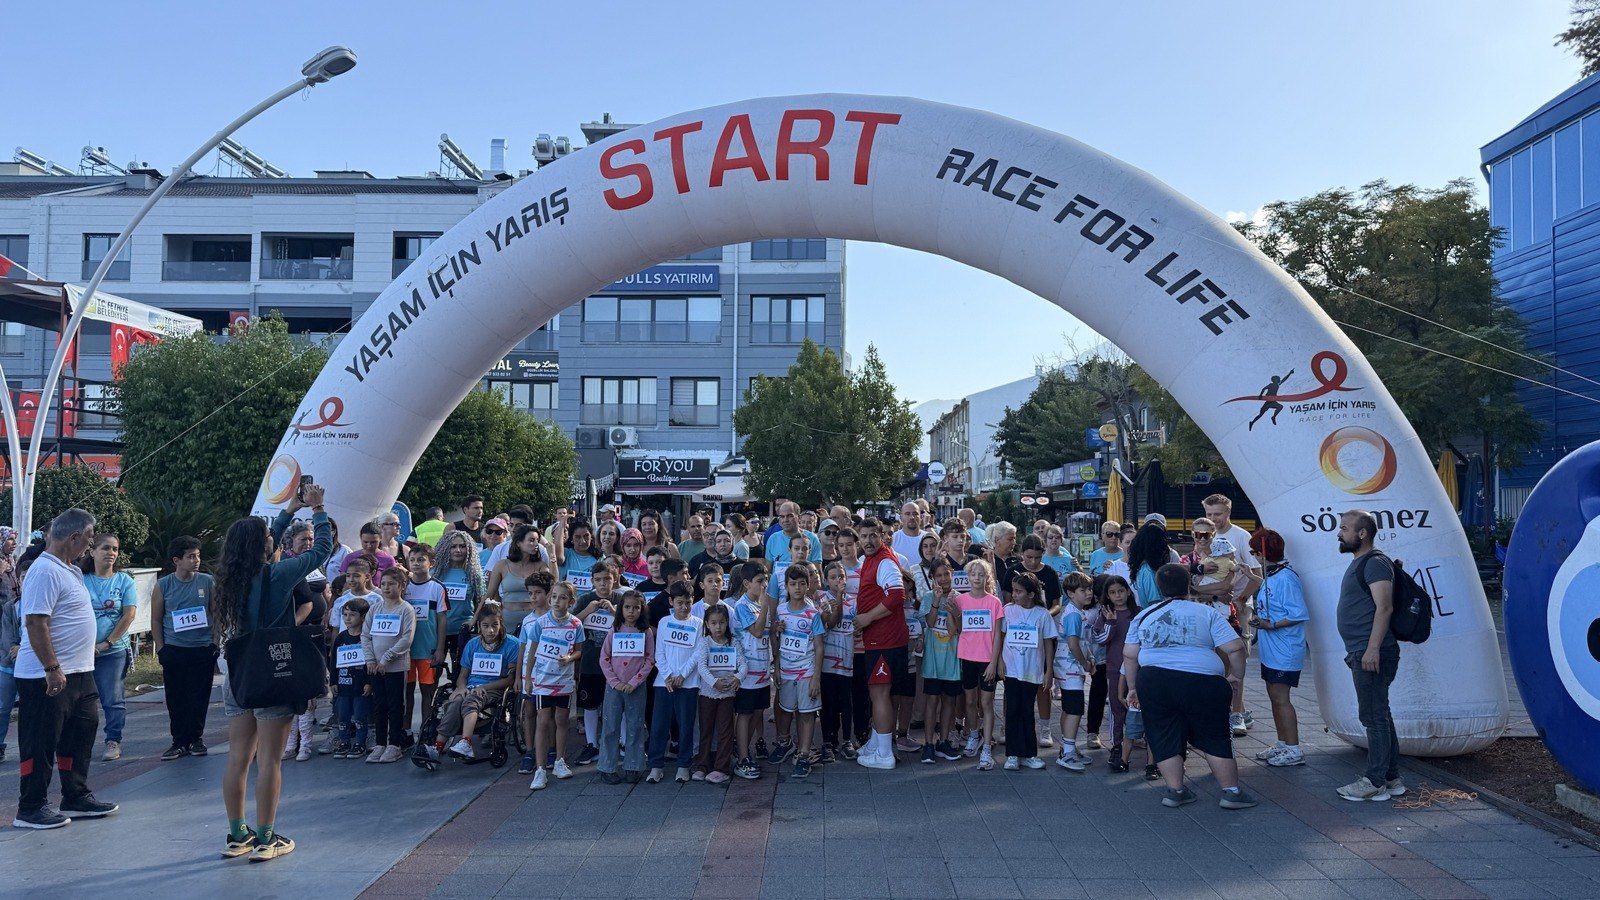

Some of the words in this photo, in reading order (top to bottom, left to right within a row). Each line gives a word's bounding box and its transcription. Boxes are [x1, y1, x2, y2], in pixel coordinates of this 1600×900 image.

[600, 109, 902, 211] START
[936, 148, 1058, 212] RACE
[1053, 194, 1155, 264] FOR
[1144, 251, 1250, 336] LIFE
[663, 273, 713, 284] YATIRIM
[345, 287, 427, 383] YAŞAM
[485, 186, 570, 253] YARIŞ
[519, 360, 541, 369] Beauty
[1290, 401, 1325, 414] YAŞAM
[1328, 399, 1348, 412] İÇİN
[1350, 401, 1376, 411] YARIŞ
[1299, 415, 1323, 423] RACE
[302, 432, 321, 440] YAŞAM
[322, 431, 336, 440] İÇİN
[337, 432, 360, 440] YARIŞ
[634, 460, 661, 472] FOR
[666, 460, 694, 472] YOU
[647, 473, 680, 485] Boutique
[1301, 506, 1433, 533] sömez
[573, 577, 587, 586] 211
[954, 577, 969, 586] 073
[179, 614, 198, 625] 118
[590, 615, 608, 625] 089
[968, 616, 985, 626] 068
[377, 620, 393, 630] 107
[671, 630, 689, 641] 006
[1013, 631, 1030, 641] 122
[268, 643, 292, 651] AFTER
[618, 641, 636, 650] 113
[784, 637, 800, 648] 076
[543, 644, 560, 655] 123
[342, 651, 358, 661] 109
[713, 655, 729, 664] 009
[479, 661, 496, 669] 010
